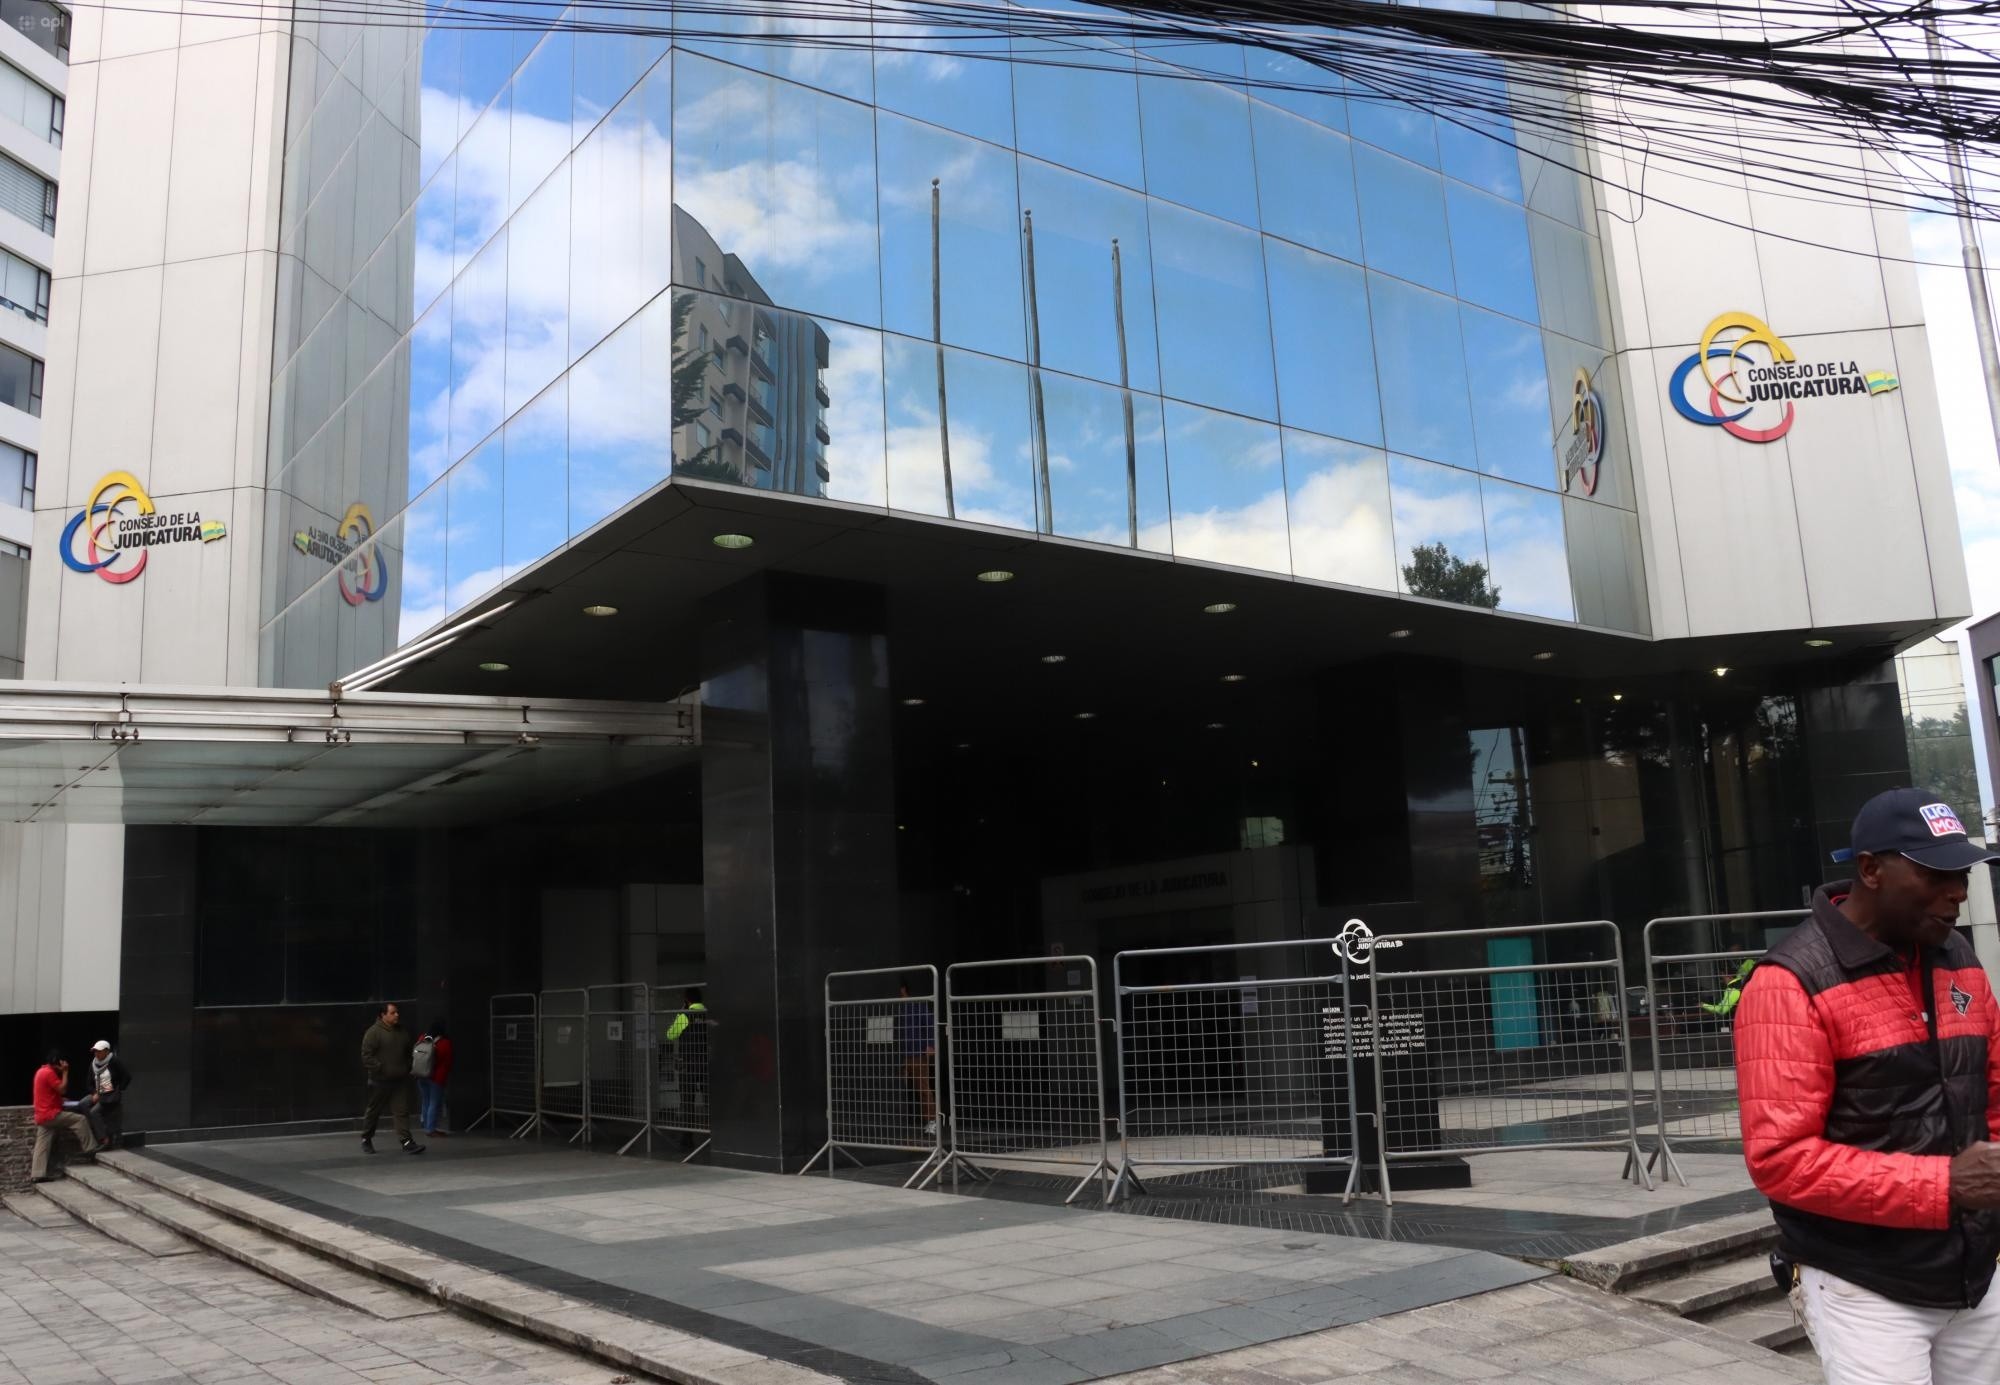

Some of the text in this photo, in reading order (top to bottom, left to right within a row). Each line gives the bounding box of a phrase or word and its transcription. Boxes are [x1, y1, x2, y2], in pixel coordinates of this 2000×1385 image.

[1748, 361, 1860, 383] CONSEJO DE LA
[1746, 376, 1867, 402] JUDICATURA
[119, 511, 200, 532] CONSEJO DE LA
[114, 525, 202, 549] JUDICATURA
